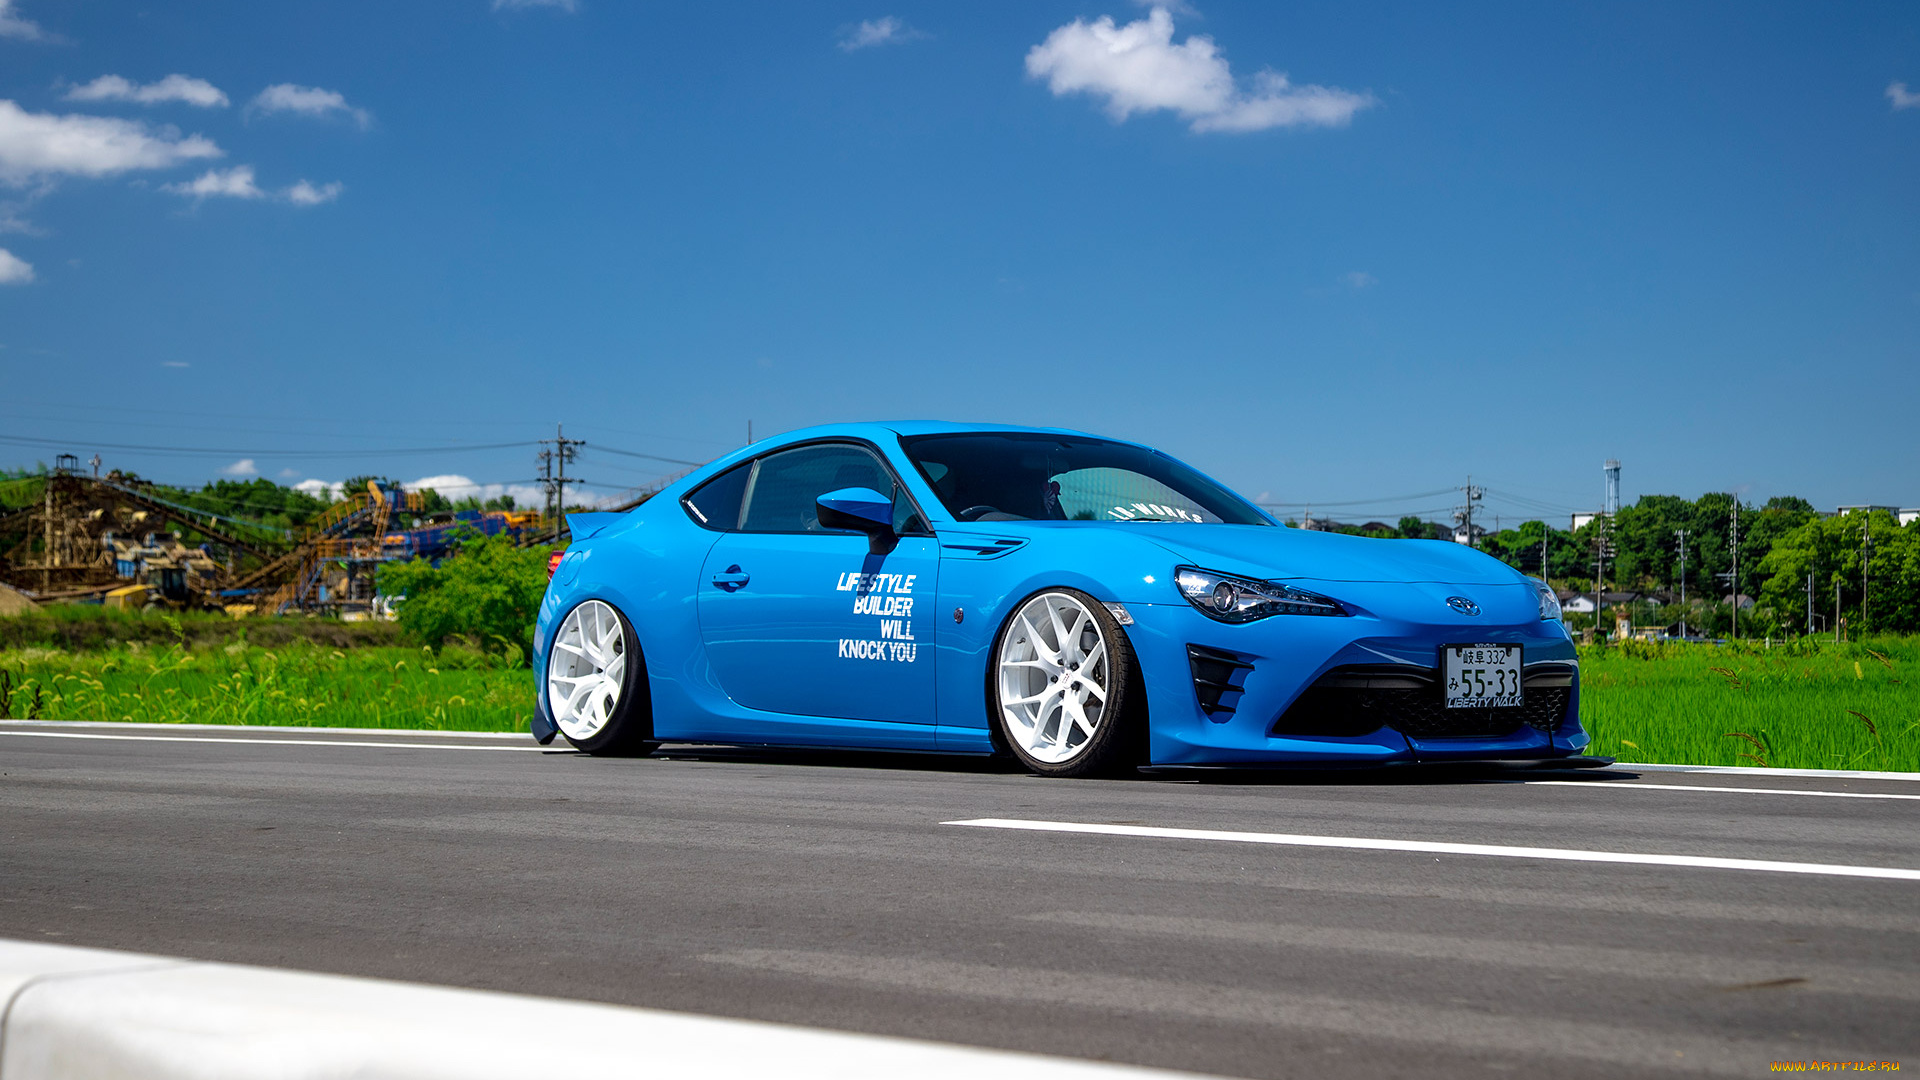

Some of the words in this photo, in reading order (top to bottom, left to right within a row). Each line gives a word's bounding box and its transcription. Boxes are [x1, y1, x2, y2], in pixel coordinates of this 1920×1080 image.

[836, 572, 917, 594] LIFESTYLE
[853, 595, 914, 617] BUILDER
[880, 619, 915, 640] WILL
[838, 638, 887, 661] KNOCK
[888, 641, 917, 663] YOU
[1463, 650, 1485, 665] 岐阜
[1486, 650, 1505, 665] 332
[1448, 677, 1459, 691] み
[1462, 669, 1518, 698] 55-33
[1447, 697, 1491, 709] LIBERTY
[1492, 696, 1523, 707] WALK
